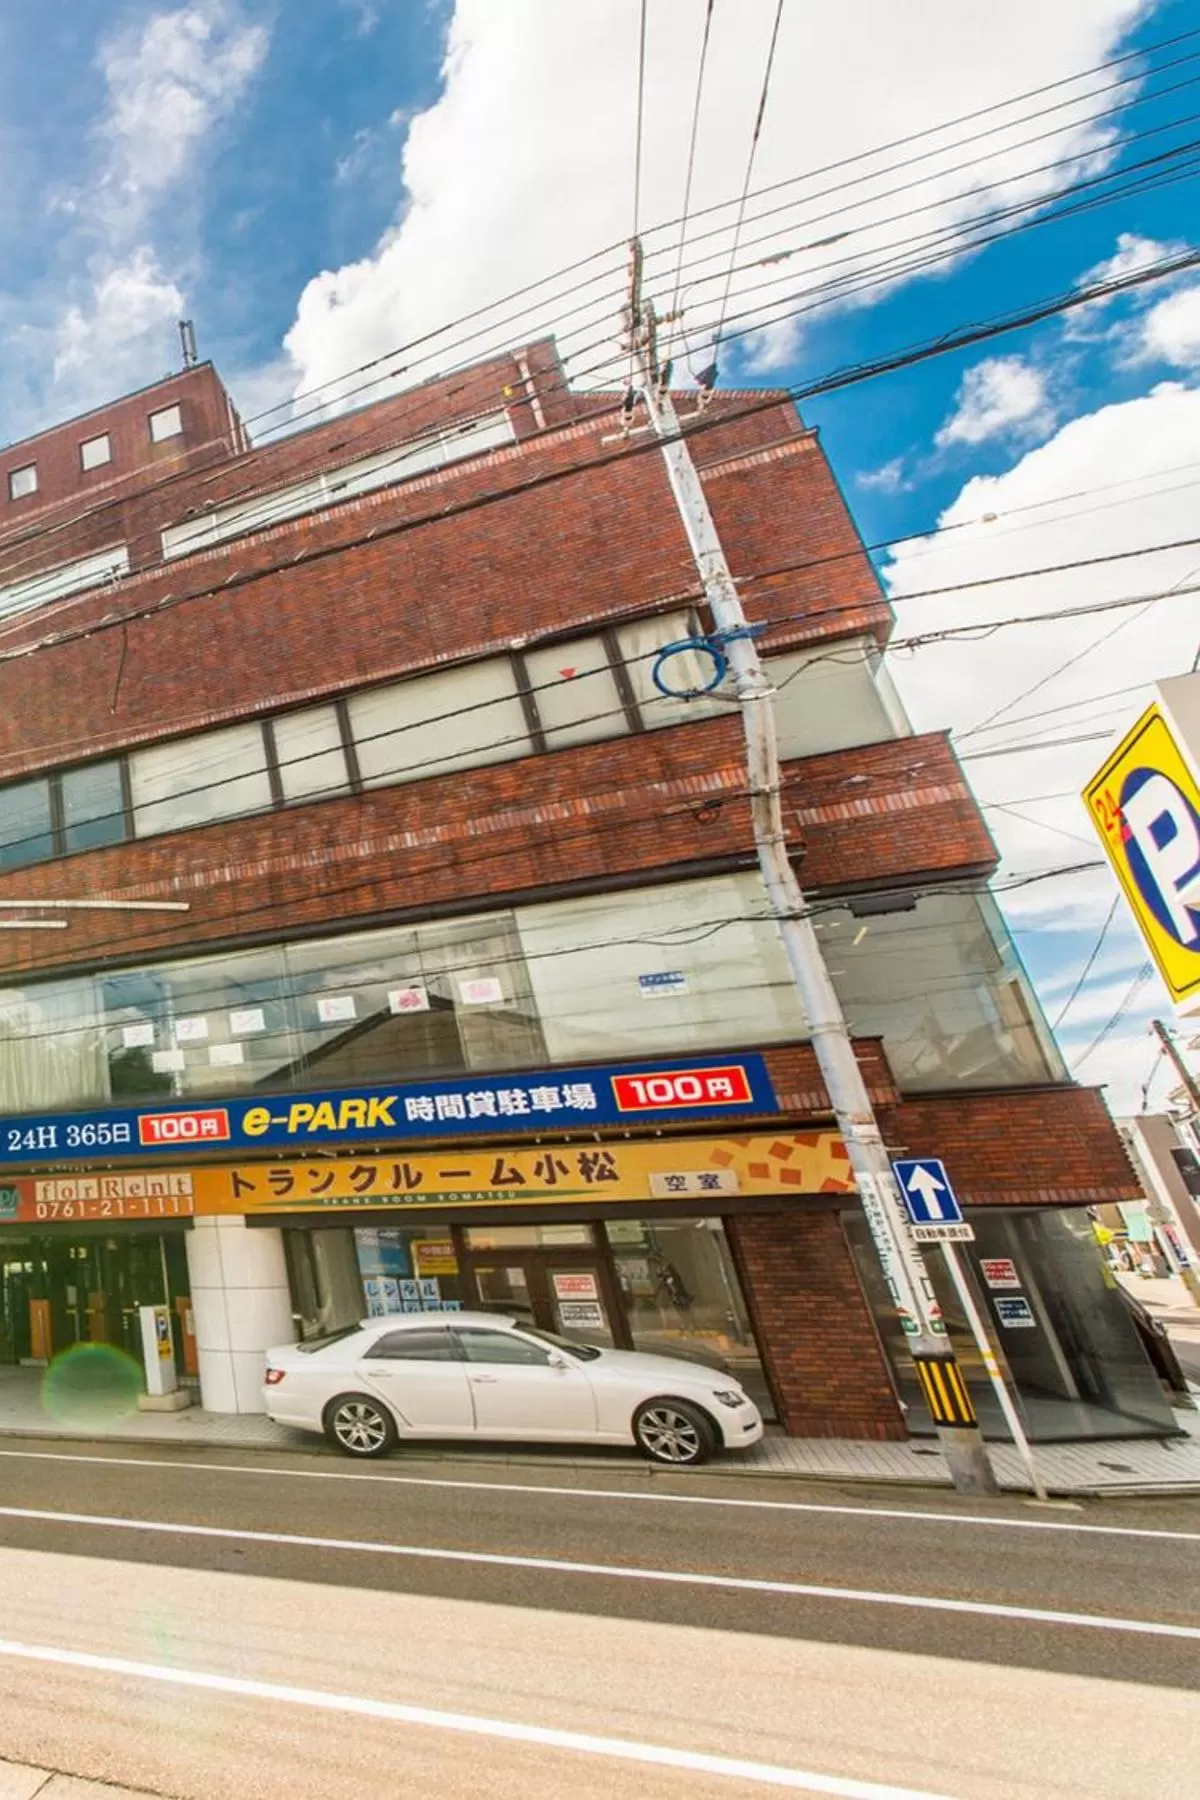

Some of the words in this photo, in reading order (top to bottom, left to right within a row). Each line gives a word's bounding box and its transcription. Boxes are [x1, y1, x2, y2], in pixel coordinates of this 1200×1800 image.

[1120, 774, 1200, 945] P
[629, 1076, 734, 1105] 100円
[242, 1095, 398, 1136] e-PARK
[405, 1083, 597, 1122] 時間貸駐車場
[8, 1125, 58, 1151] 24H
[66, 1122, 131, 1147] 365日
[150, 1117, 219, 1140] 100円
[231, 1151, 620, 1199] トランクルーム小松
[664, 1173, 722, 1191] 空室
[36, 1196, 195, 1219] 0761-21-1111
